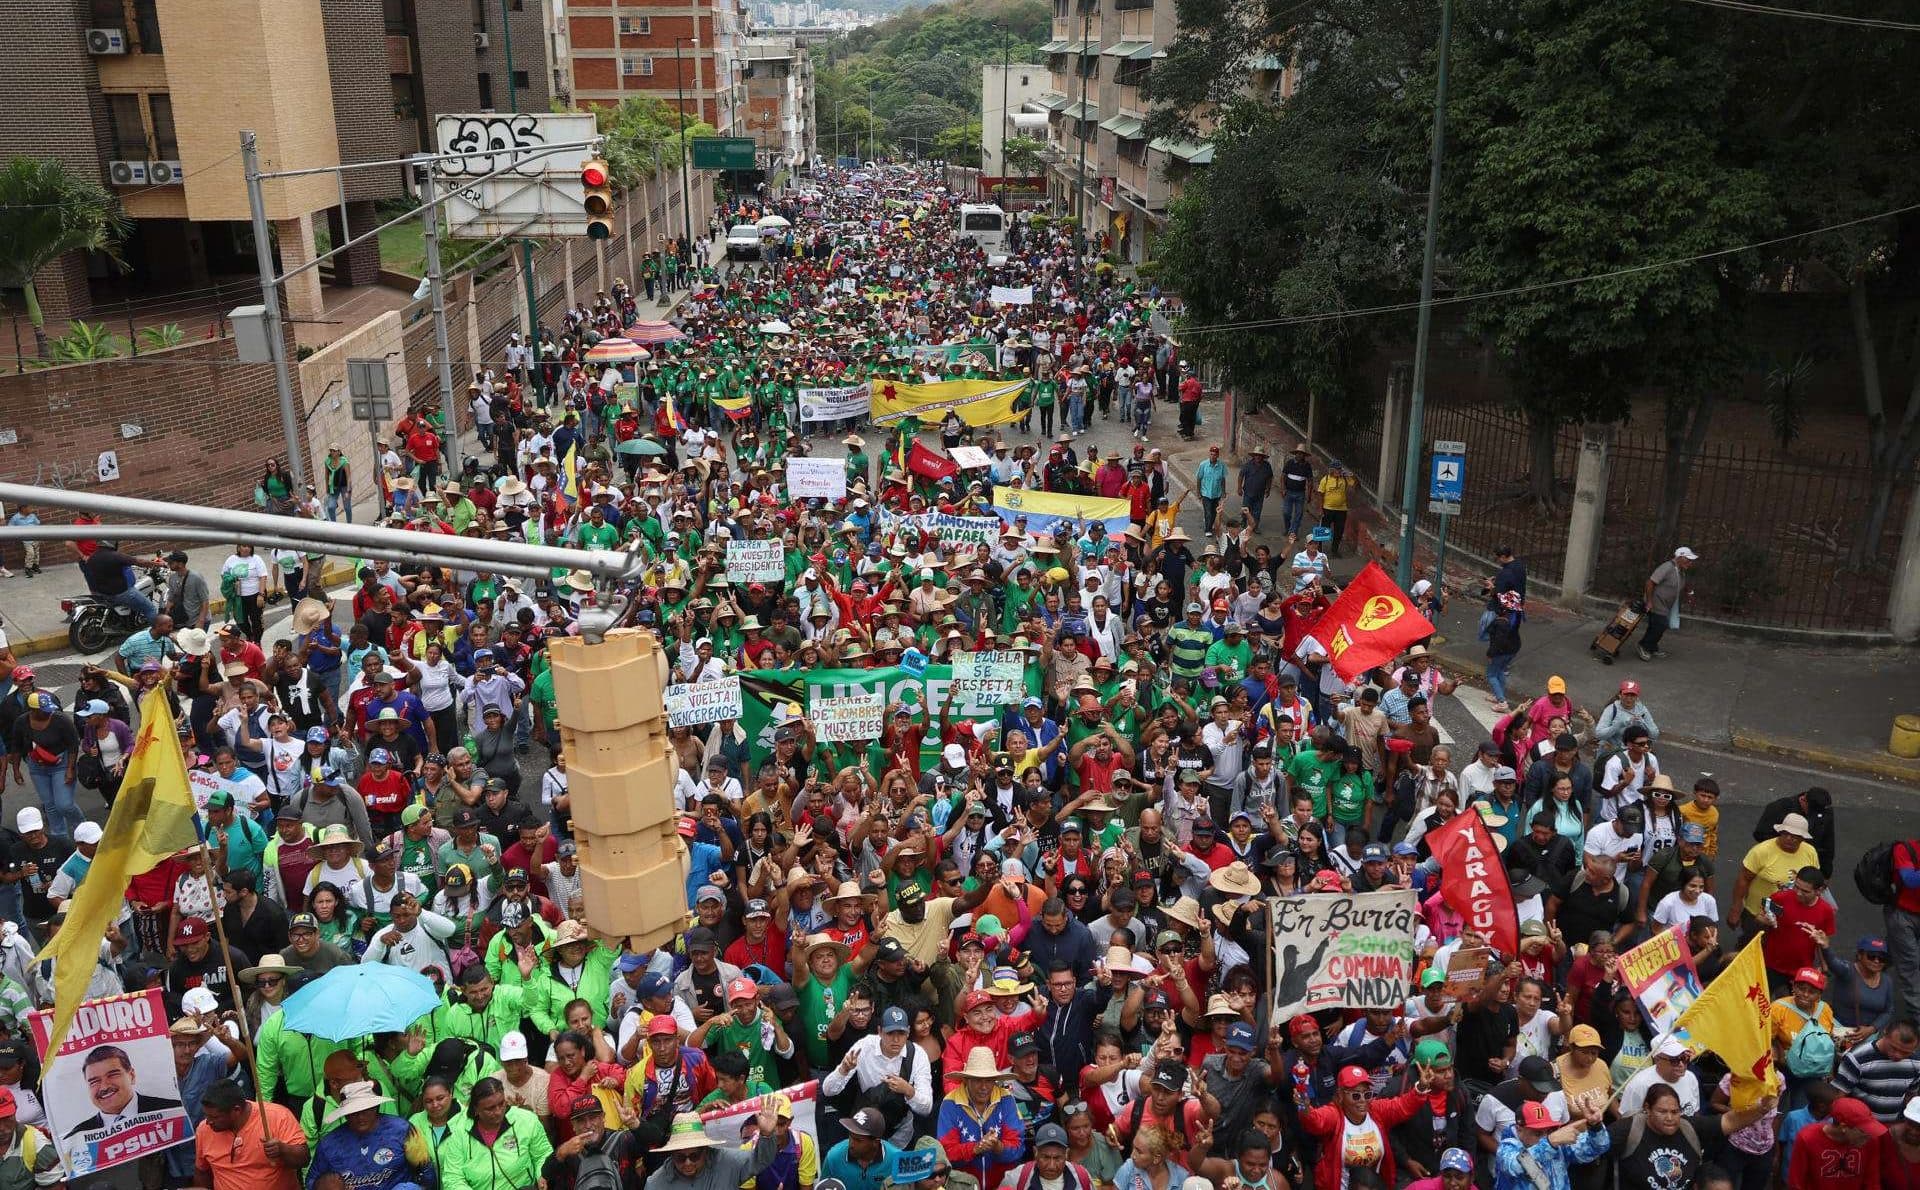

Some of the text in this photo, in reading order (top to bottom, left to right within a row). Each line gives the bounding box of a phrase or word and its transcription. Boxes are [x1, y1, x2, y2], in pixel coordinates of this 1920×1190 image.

[741, 549, 780, 560] NUESTRO
[727, 560, 784, 572] PRESIDENTE
[952, 650, 1021, 663] VENEZUELA
[974, 665, 992, 677] SE
[668, 678, 738, 697] LOS QUEREMOS
[955, 678, 1013, 691] RESPETA
[976, 693, 1001, 705] PAZ
[670, 705, 738, 726] VENCEREMOS
[812, 709, 829, 720] DE
[824, 720, 882, 735] MUJERES
[1458, 826, 1497, 948] YARACUY
[1275, 899, 1315, 938] En
[1328, 956, 1403, 980] COMUNA
[1626, 940, 1681, 989] PUEBLO
[1346, 977, 1405, 1006] NADA
[57, 1027, 154, 1054] RESIDENTE
[124, 1112, 164, 1131] MADURO
